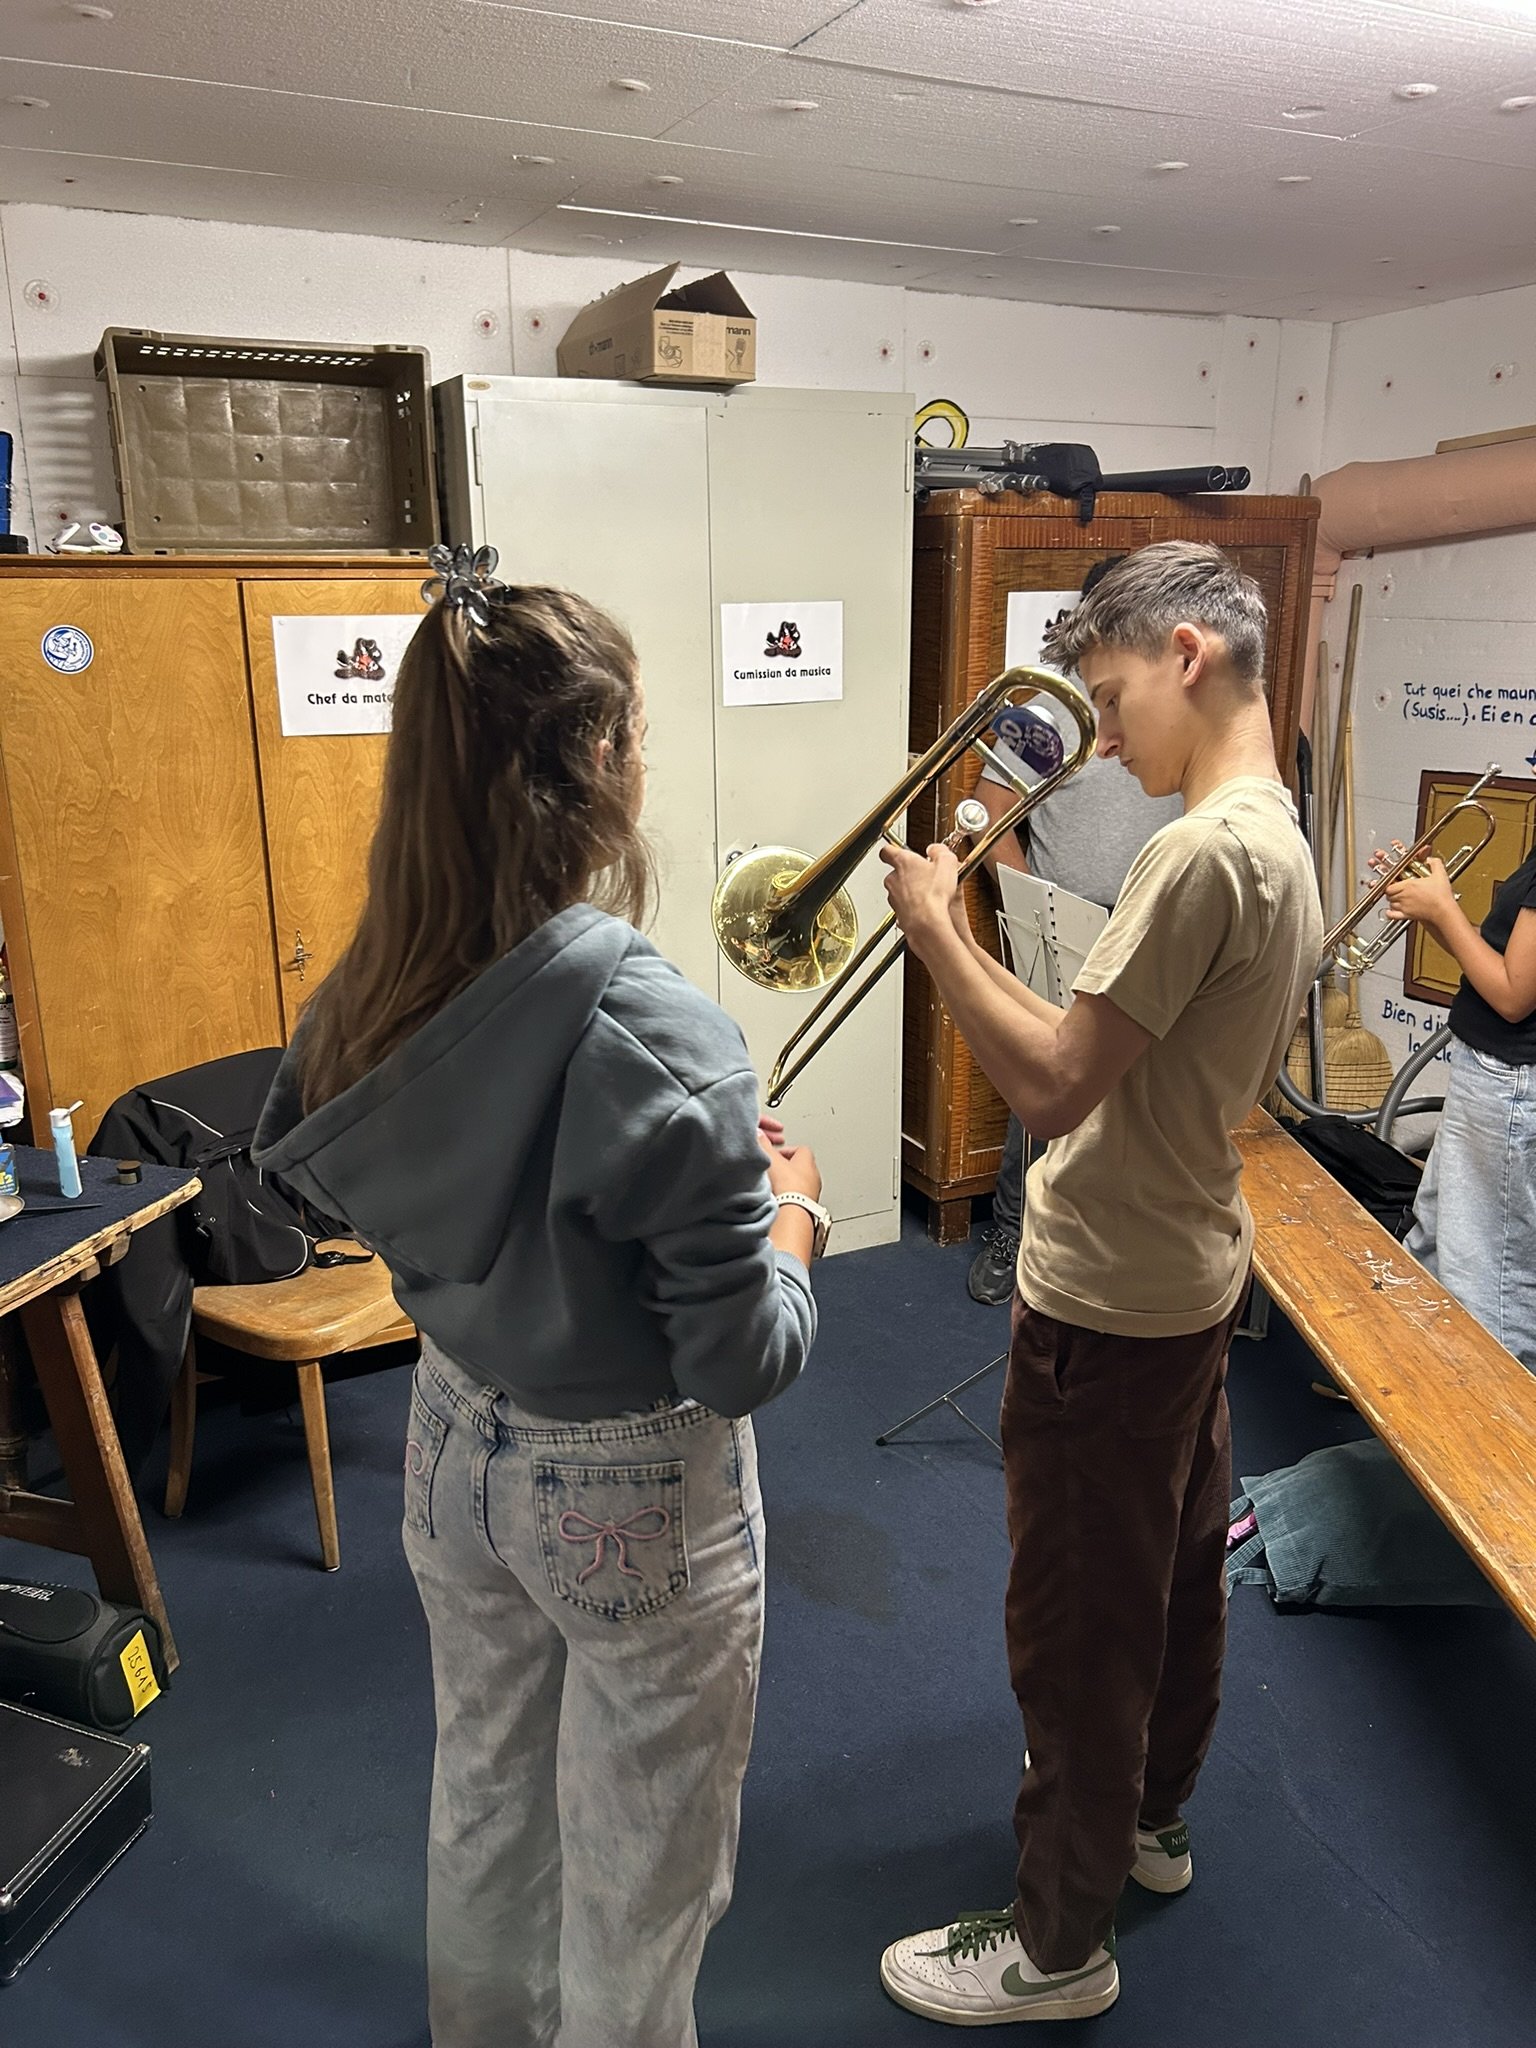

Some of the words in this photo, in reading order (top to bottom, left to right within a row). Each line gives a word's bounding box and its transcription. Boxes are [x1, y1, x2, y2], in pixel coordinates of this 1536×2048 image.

[734, 668, 782, 680] Cumissiun
[785, 668, 797, 678] da
[800, 666, 831, 677] musica
[307, 693, 336, 705] Chef
[342, 692, 357, 704] da
[1404, 683, 1426, 696] Tut
[1433, 684, 1461, 701] quei
[1467, 683, 1492, 699] che
[1382, 999, 1416, 1027] Bien
